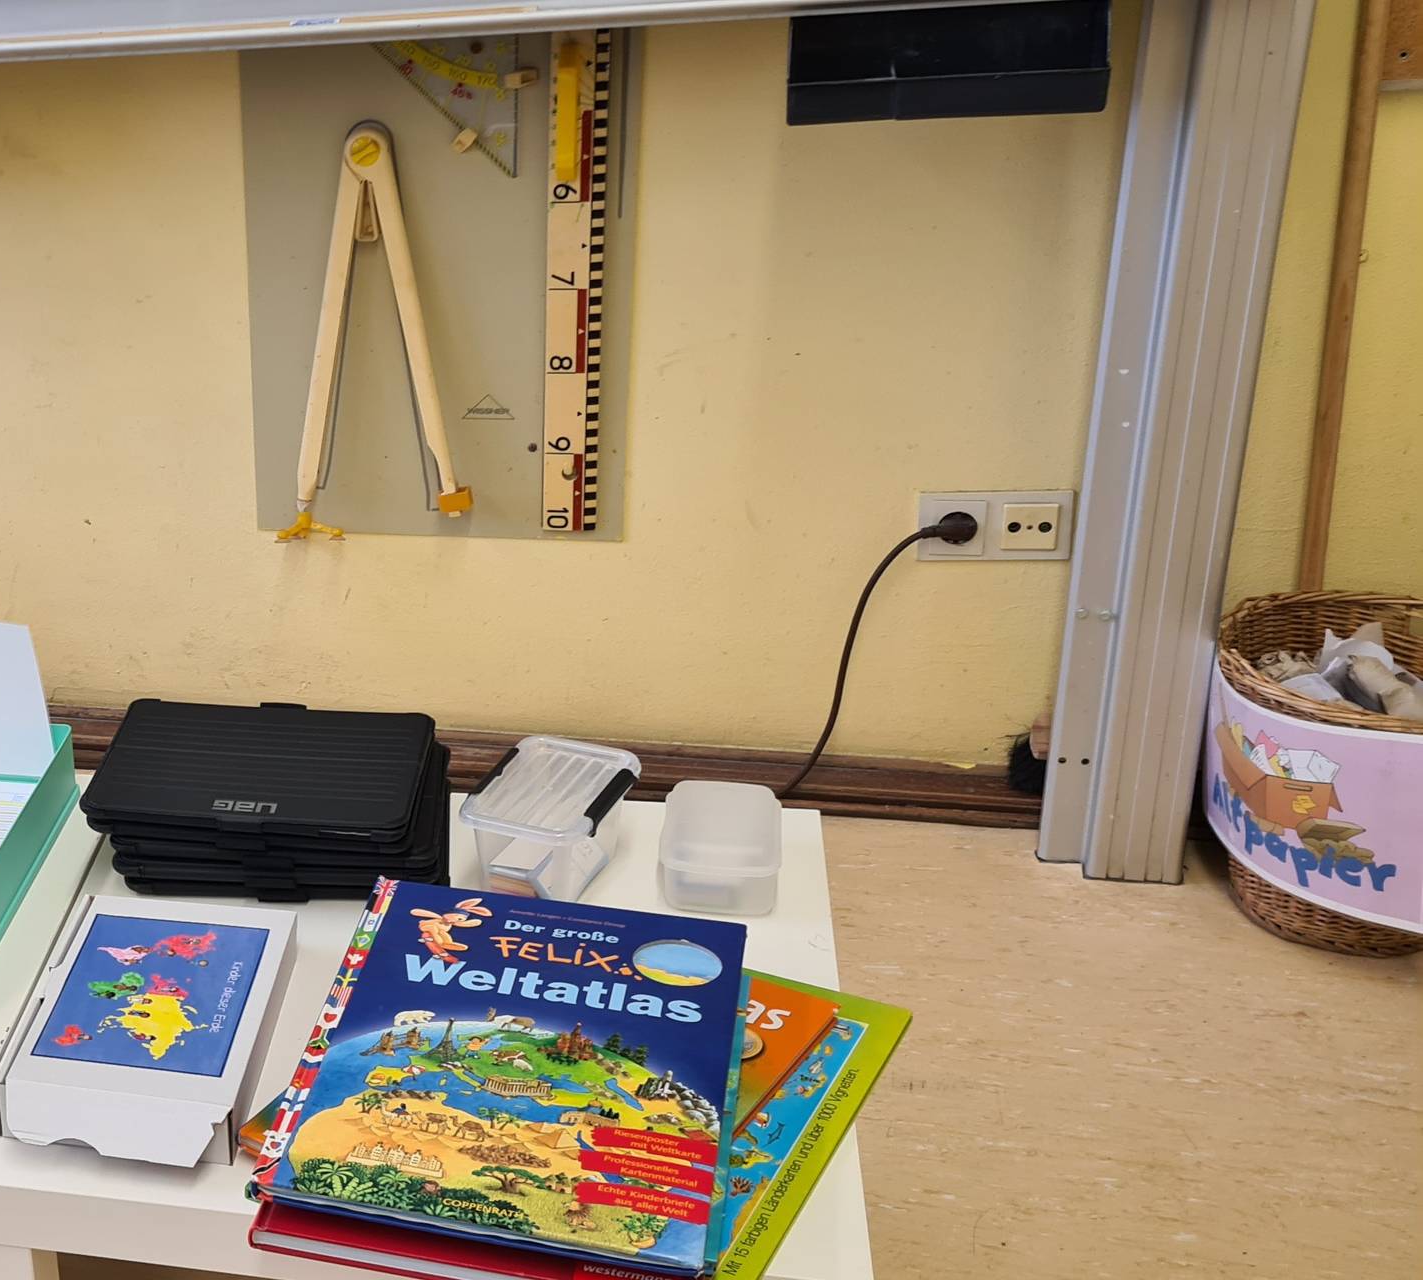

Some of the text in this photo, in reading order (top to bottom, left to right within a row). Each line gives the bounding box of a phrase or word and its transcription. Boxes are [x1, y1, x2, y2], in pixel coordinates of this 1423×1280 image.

[553, 183, 577, 200] 6
[551, 271, 575, 288] 7
[549, 355, 573, 371] 8
[547, 436, 571, 453] 9
[546, 507, 570, 529] 10
[503, 919, 620, 944] Der große
[405, 953, 703, 1023] Weltatlas
[208, 1013, 227, 1034] Erde
[817, 1101, 837, 1122] 1000
[613, 1129, 679, 1146] Riesenposter
[806, 1122, 825, 1142] über
[630, 1140, 702, 1160] mit Weltkarte
[798, 1141, 814, 1159] und
[603, 1154, 680, 1175] Professionelles
[620, 1166, 698, 1188] Kartenmaterial
[765, 1159, 802, 1213] Länderkarten
[597, 1184, 696, 1210] Echte Kinderbriefe
[615, 1197, 689, 1217] aus aller Welt
[442, 1197, 525, 1219] COPPENRATH
[741, 1211, 770, 1248] farbigen
[734, 1243, 750, 1259] 15
[721, 1259, 743, 1277] Mit
